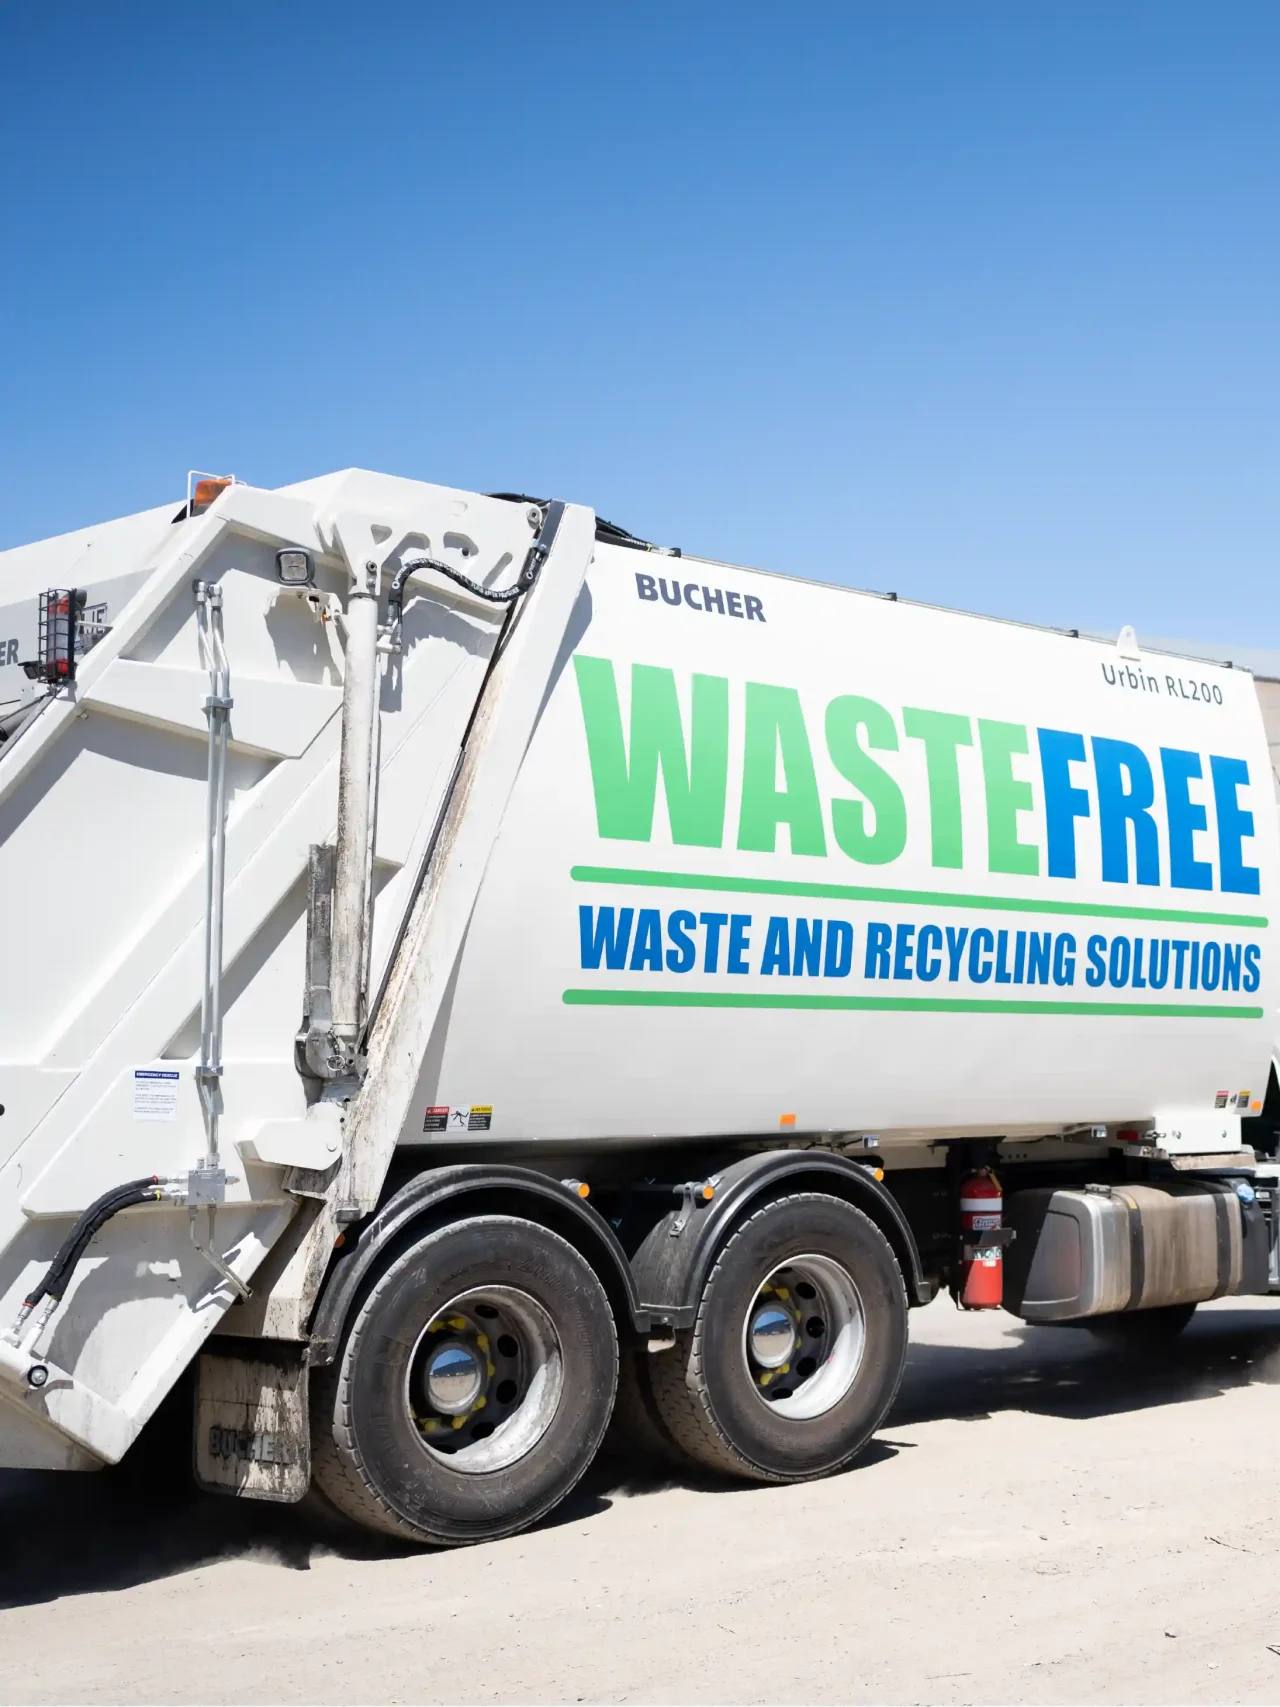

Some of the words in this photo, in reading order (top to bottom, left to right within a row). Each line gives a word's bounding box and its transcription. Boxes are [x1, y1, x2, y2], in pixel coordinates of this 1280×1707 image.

[635, 573, 767, 622] BUCHER
[1101, 663, 1159, 693] Urbin
[1165, 675, 1223, 705] RL200
[573, 654, 1261, 895] WASTEFREE
[579, 905, 752, 974] WASTE
[760, 916, 854, 978] AND
[864, 922, 1077, 986] RECYCLING
[1085, 934, 1261, 993] SOLUTIONS
